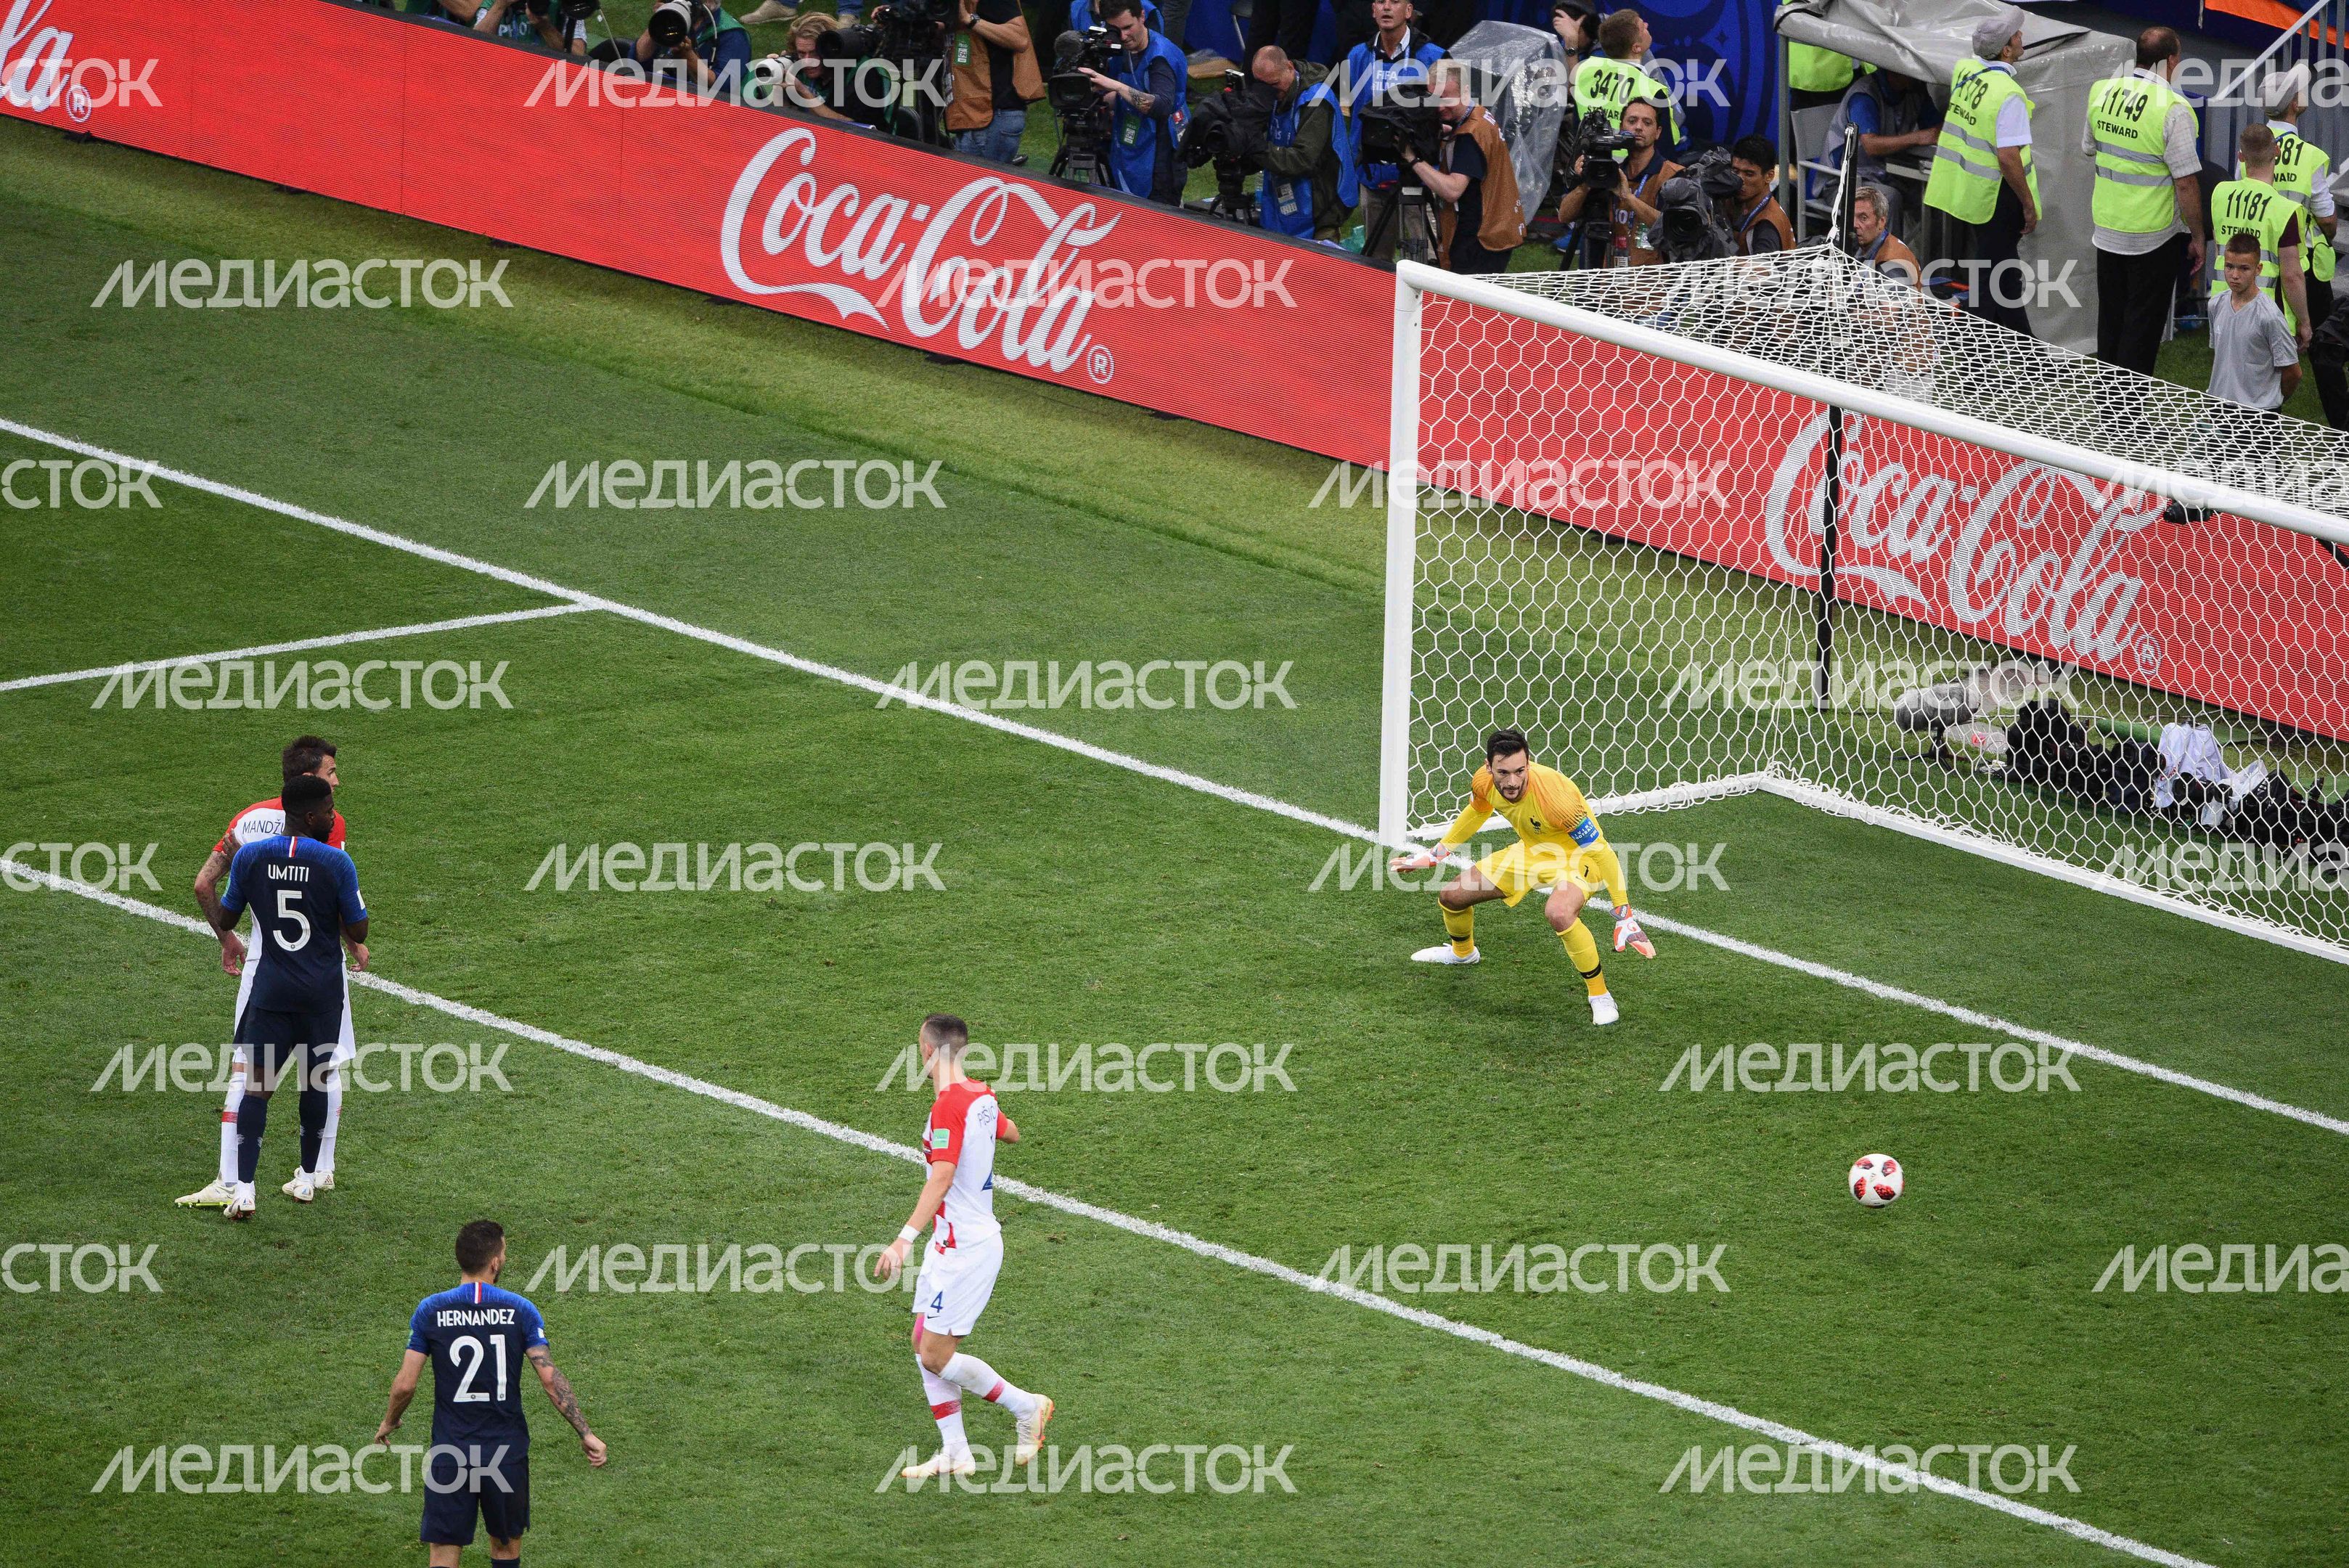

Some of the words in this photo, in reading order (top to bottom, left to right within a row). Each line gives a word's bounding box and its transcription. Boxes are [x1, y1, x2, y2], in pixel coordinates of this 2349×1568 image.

[1590, 69, 1635, 105] 3470
[2101, 86, 2149, 123] 11749
[2096, 120, 2138, 139] STEWARD
[2226, 189, 2273, 222] 11181
[268, 864, 309, 882] UMTITI
[273, 890, 311, 952] 5
[436, 1308, 515, 1328] HERNANDEZ
[930, 1290, 944, 1313] 4
[449, 1334, 507, 1402] 21
